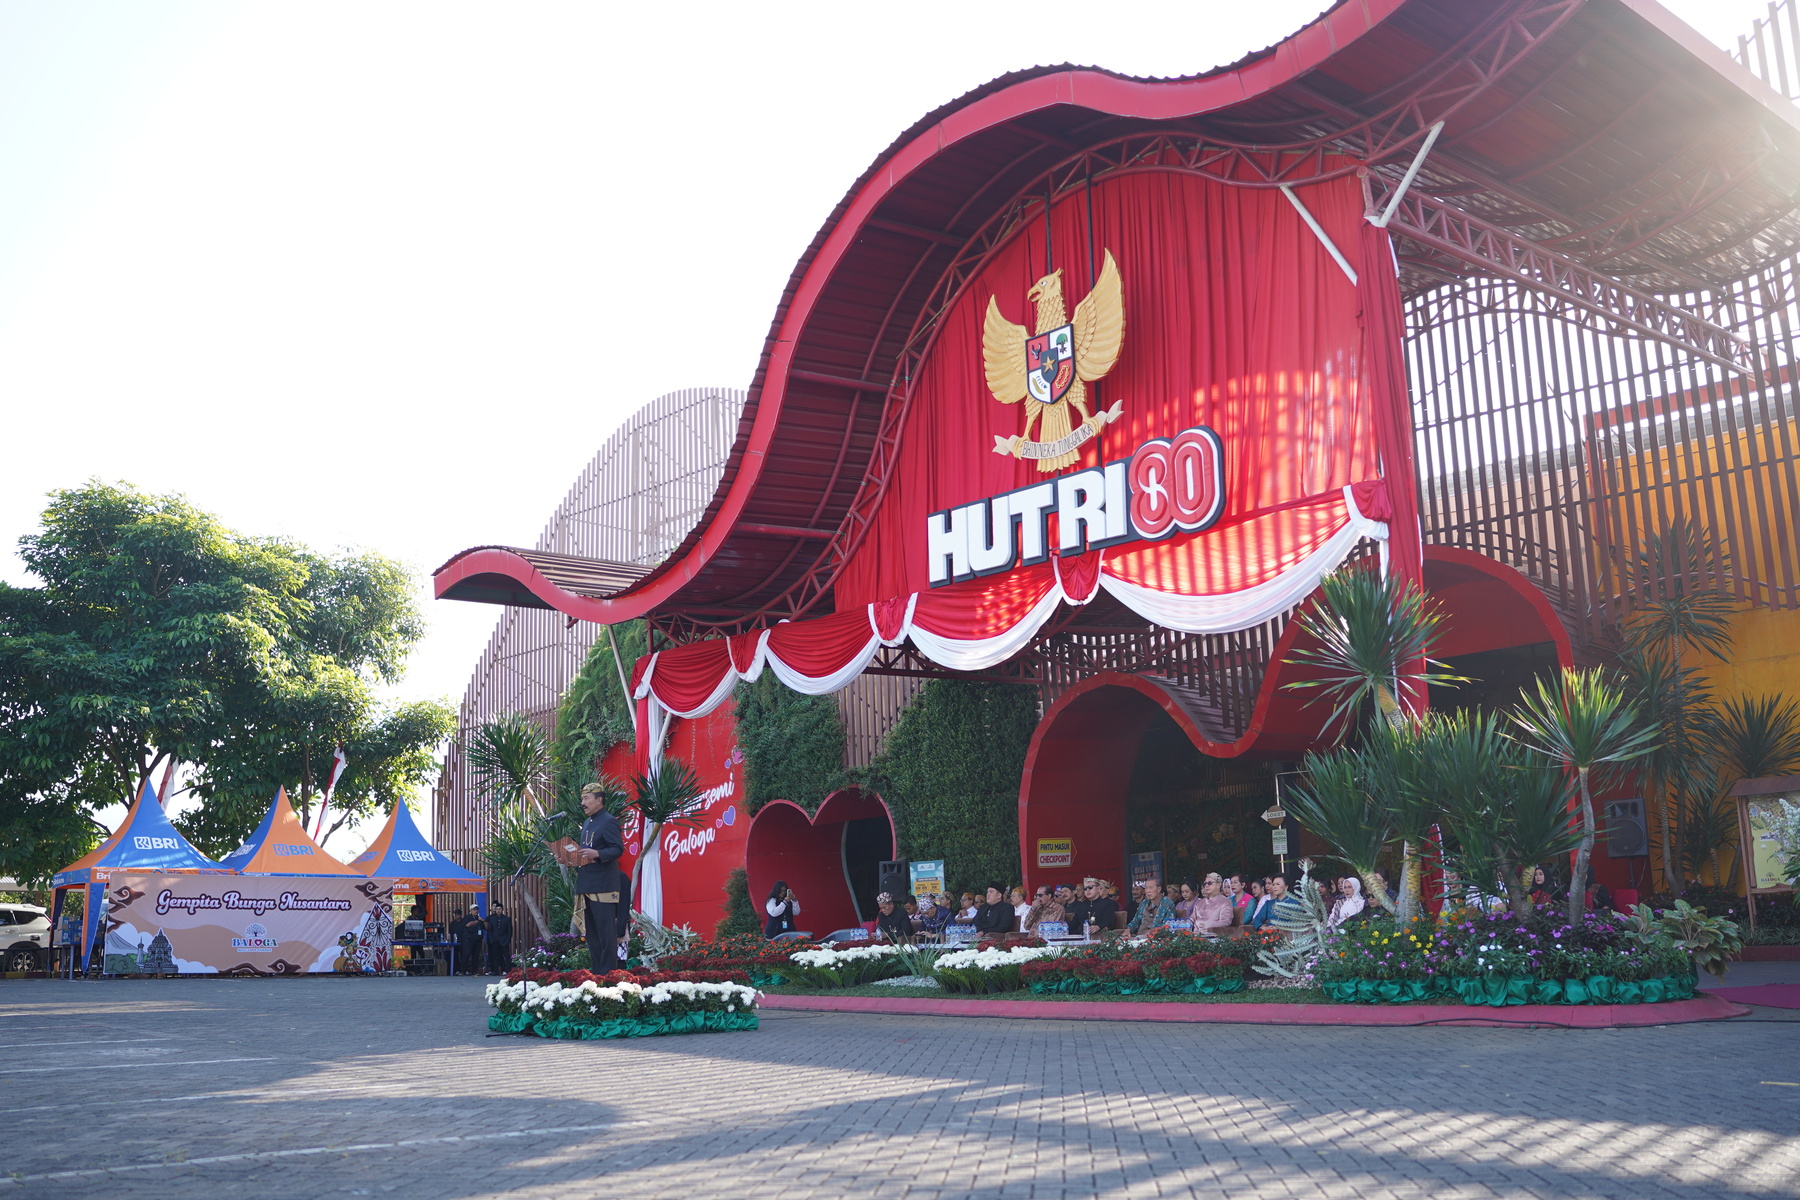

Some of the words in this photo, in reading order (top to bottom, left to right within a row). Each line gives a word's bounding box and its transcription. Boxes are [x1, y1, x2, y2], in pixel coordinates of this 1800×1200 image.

[1022, 441, 1056, 457] BHINNEKA
[1058, 432, 1082, 453] TUNGGAL
[1081, 424, 1094, 440] IKA
[1128, 428, 1221, 539] 80
[151, 837, 179, 849] BRI
[664, 827, 716, 862] Baloga
[1040, 843, 1054, 851] PINTU
[289, 845, 315, 856] BRI
[412, 850, 436, 861] BRI
[1040, 854, 1070, 864] CHECKPOINT
[157, 890, 221, 915] Gempita
[222, 890, 277, 916] Bunga
[278, 891, 352, 912] Nusantara
